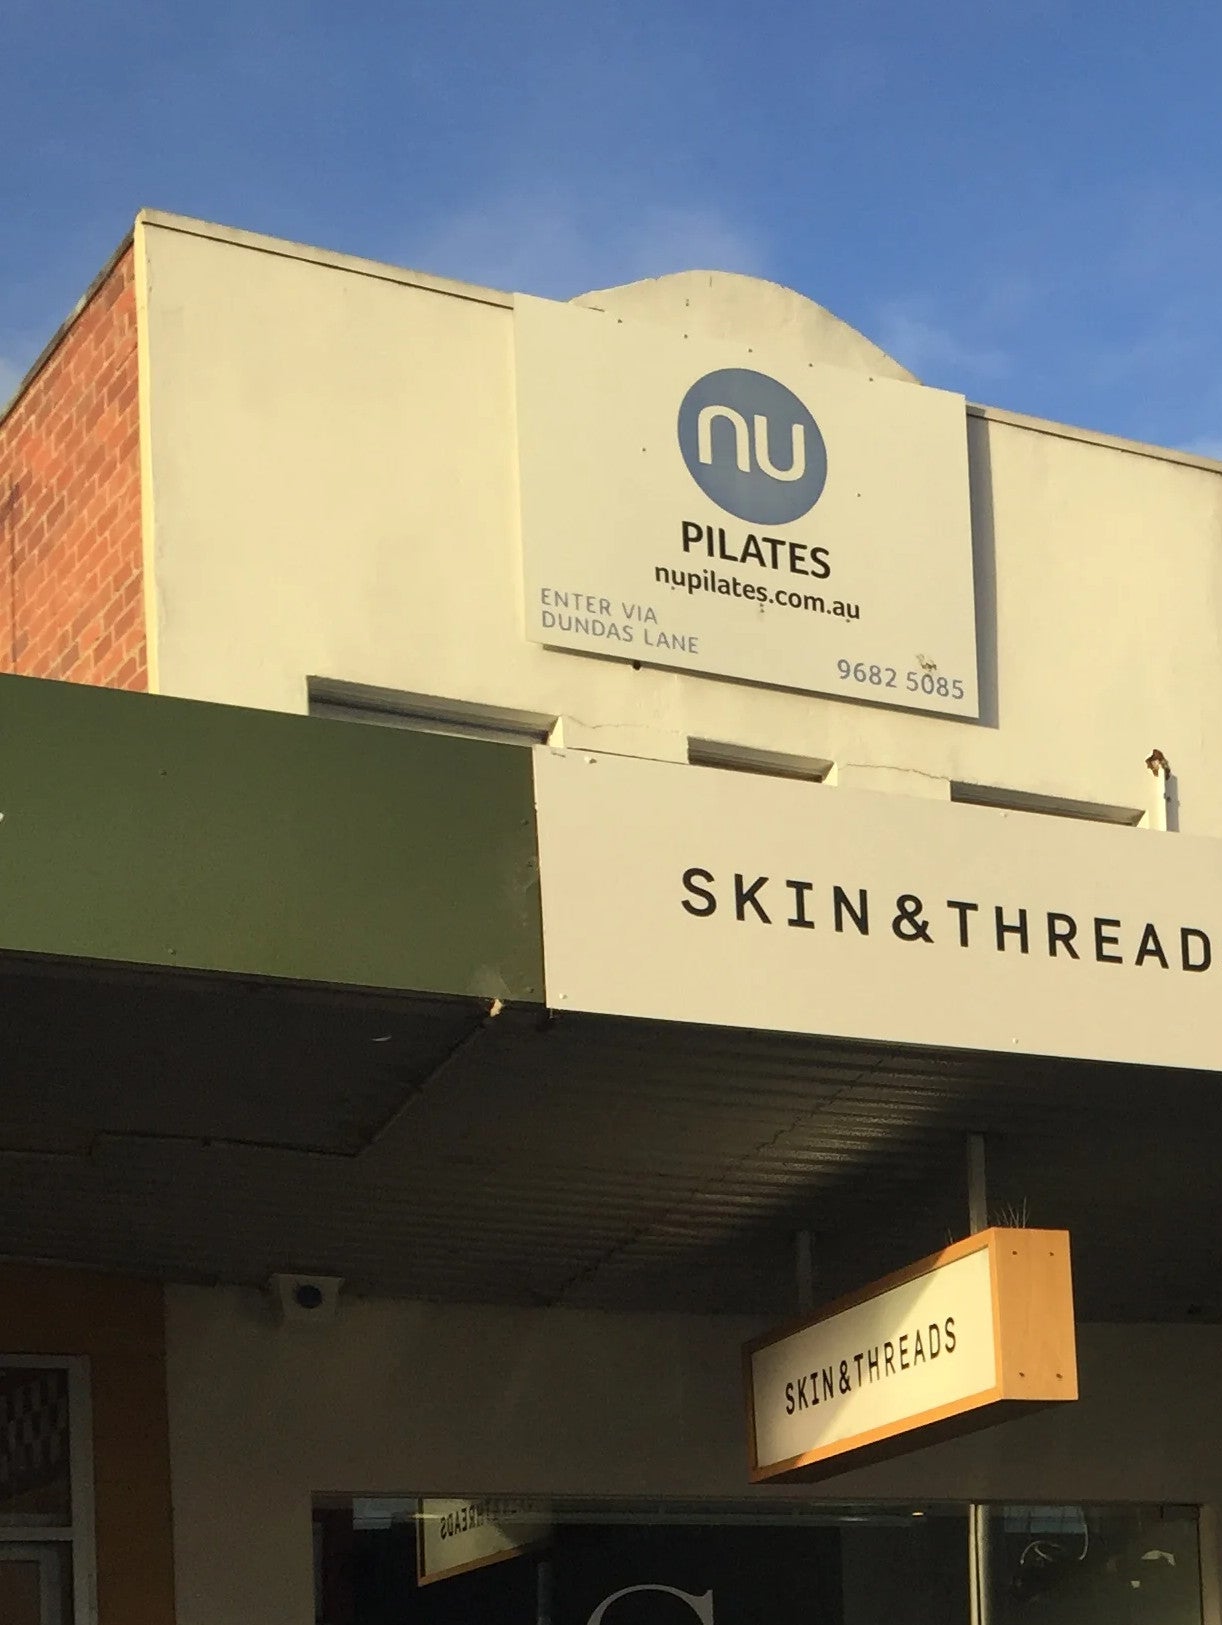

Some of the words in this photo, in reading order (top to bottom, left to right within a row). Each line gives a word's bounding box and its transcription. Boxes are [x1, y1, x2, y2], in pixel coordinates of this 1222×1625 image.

[698, 405, 806, 482] nu
[681, 520, 831, 579] PILATES
[540, 587, 612, 616] ENTER
[621, 603, 658, 625] VIA
[655, 563, 861, 620] nupilates.com.au
[541, 610, 634, 643] DUNDAS
[643, 628, 699, 655] LANE
[836, 658, 898, 689] 9682
[906, 671, 965, 701] 5085
[785, 1316, 957, 1415] SKIN&THREADS
